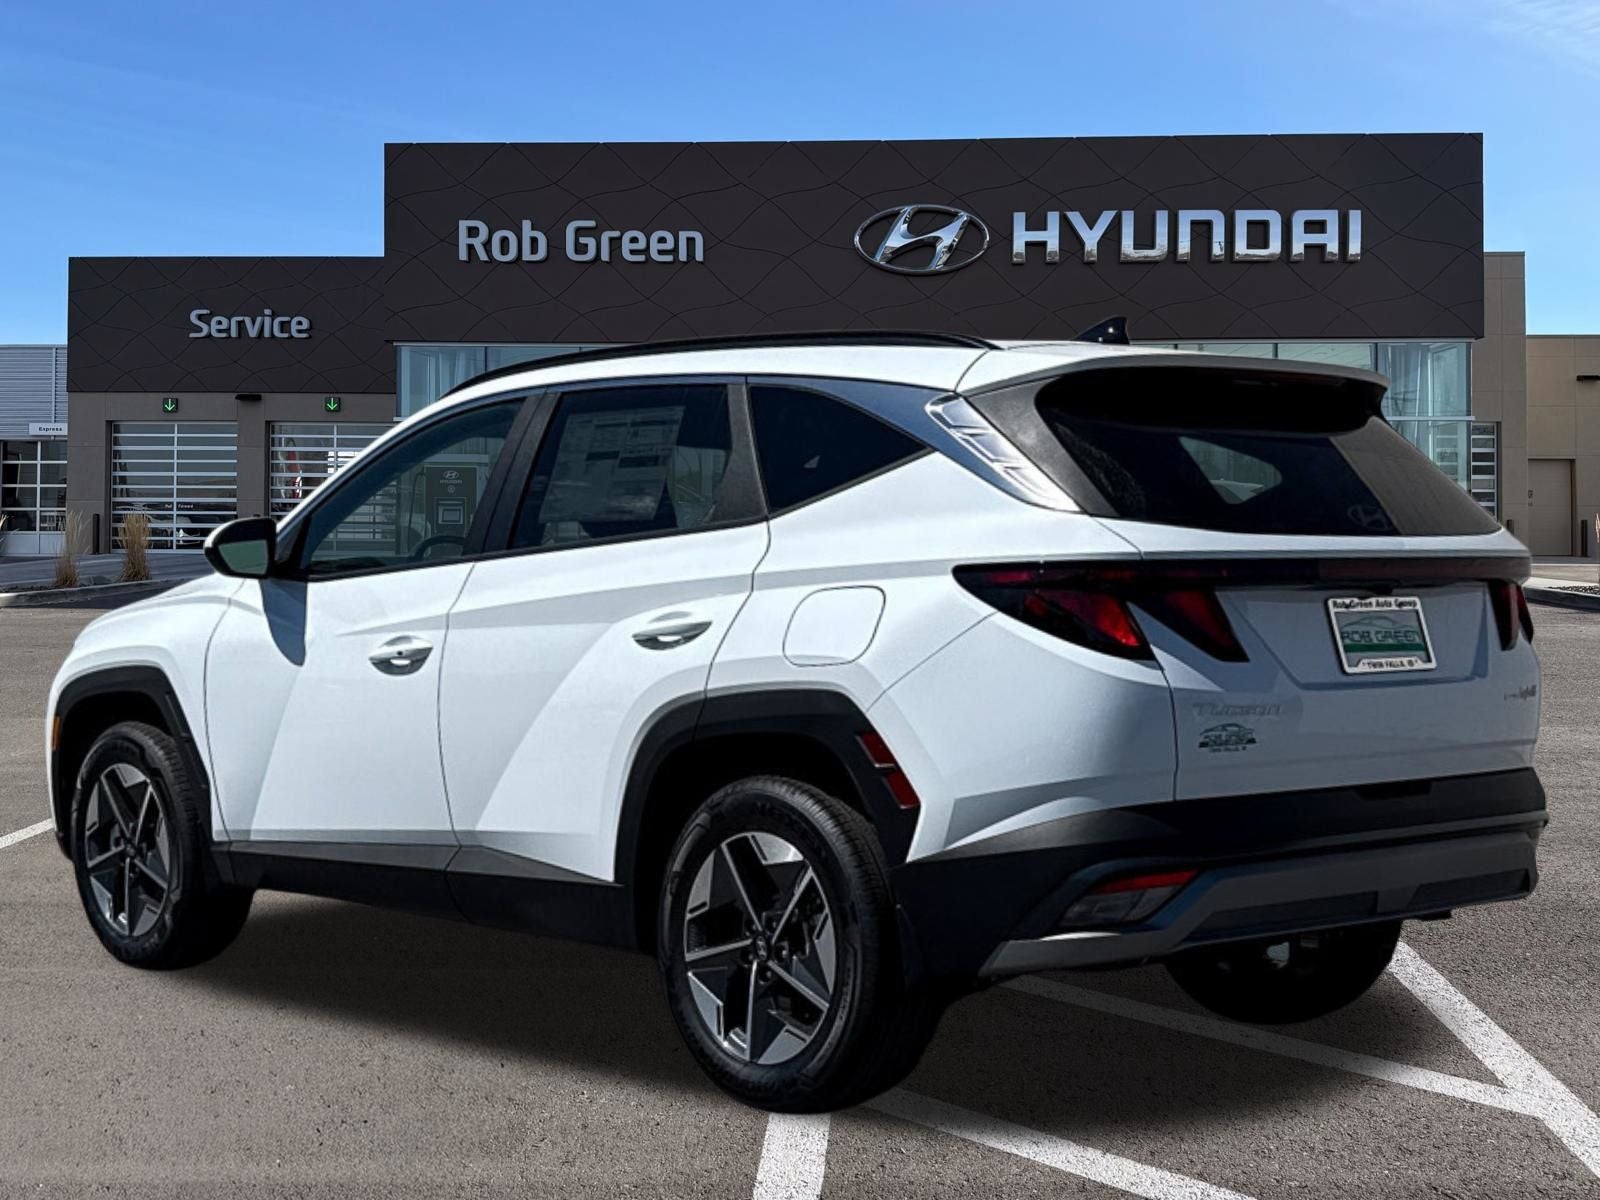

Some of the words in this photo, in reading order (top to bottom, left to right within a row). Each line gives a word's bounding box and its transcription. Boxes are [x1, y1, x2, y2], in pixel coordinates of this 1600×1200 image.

[458, 219, 549, 262] Rob
[565, 219, 705, 262] Green
[1010, 208, 1363, 265] HYUNDAI
[188, 308, 312, 338] Service
[1347, 599, 1373, 609] Green
[1375, 599, 1393, 609] Auto
[1394, 598, 1418, 609] Group
[1341, 630, 1372, 643] ROB
